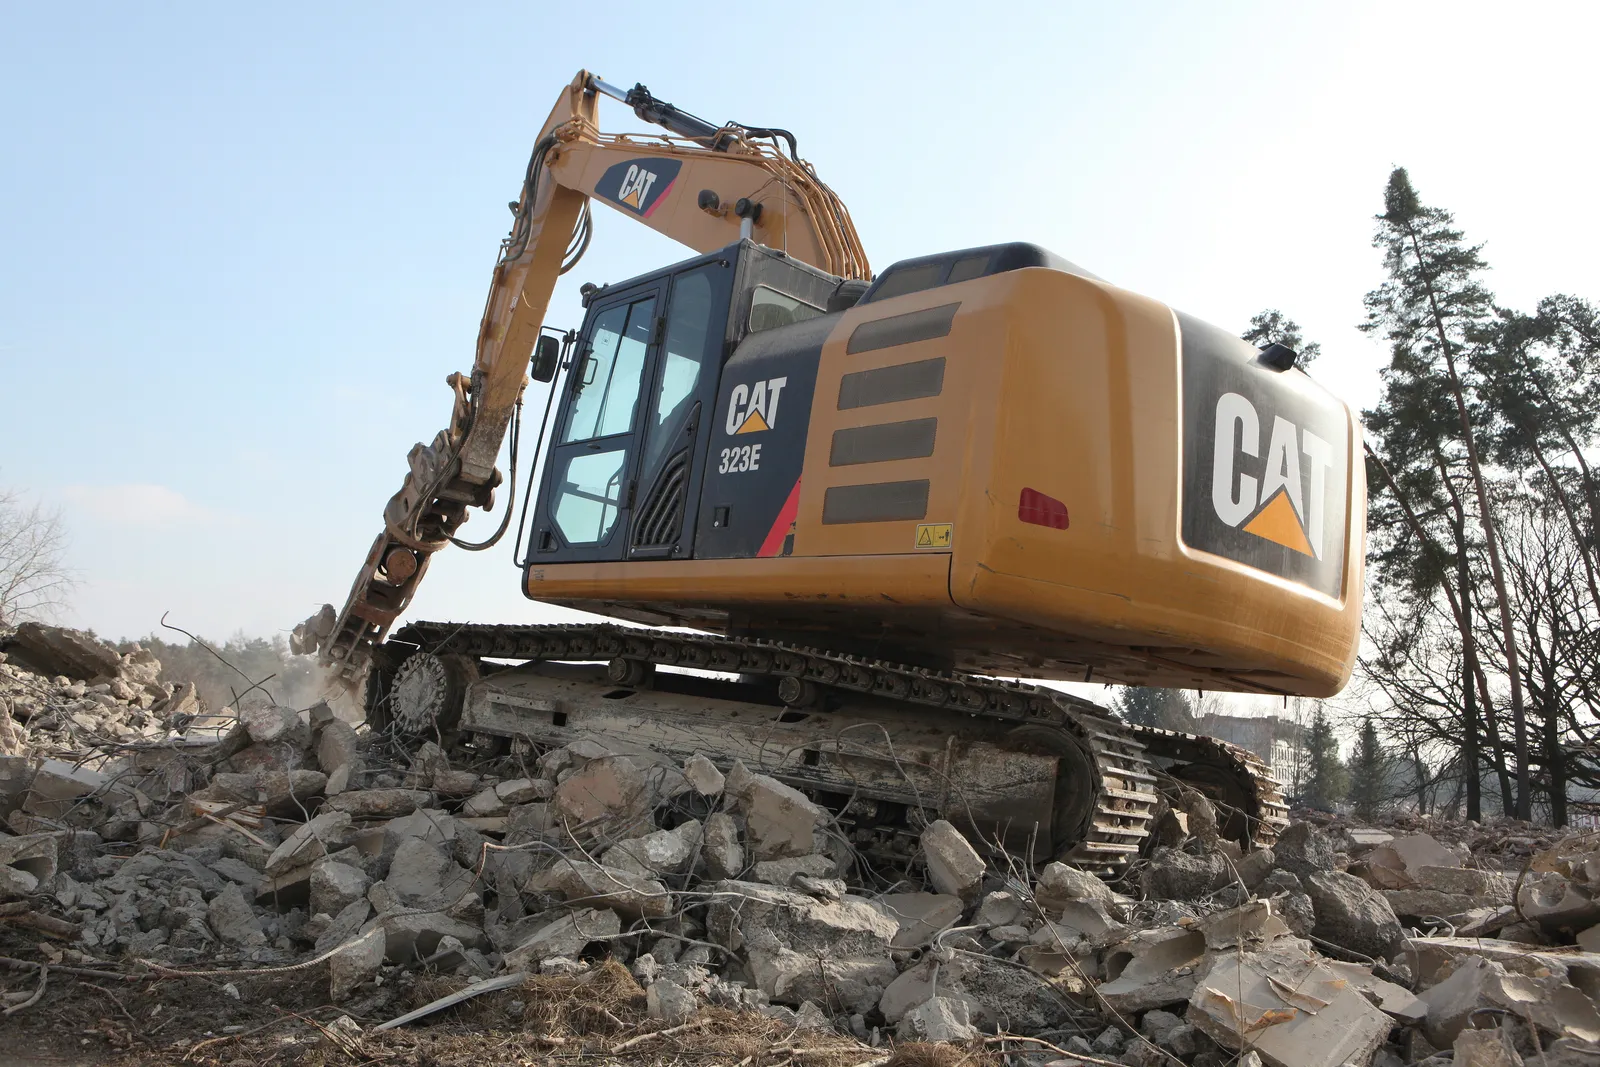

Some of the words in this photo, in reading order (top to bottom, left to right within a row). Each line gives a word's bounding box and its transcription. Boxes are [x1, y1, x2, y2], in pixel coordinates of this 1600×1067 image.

[619, 164, 657, 210] CAT
[726, 377, 787, 435] CAT
[719, 444, 762, 474] 323E
[1212, 392, 1333, 561] CAT
